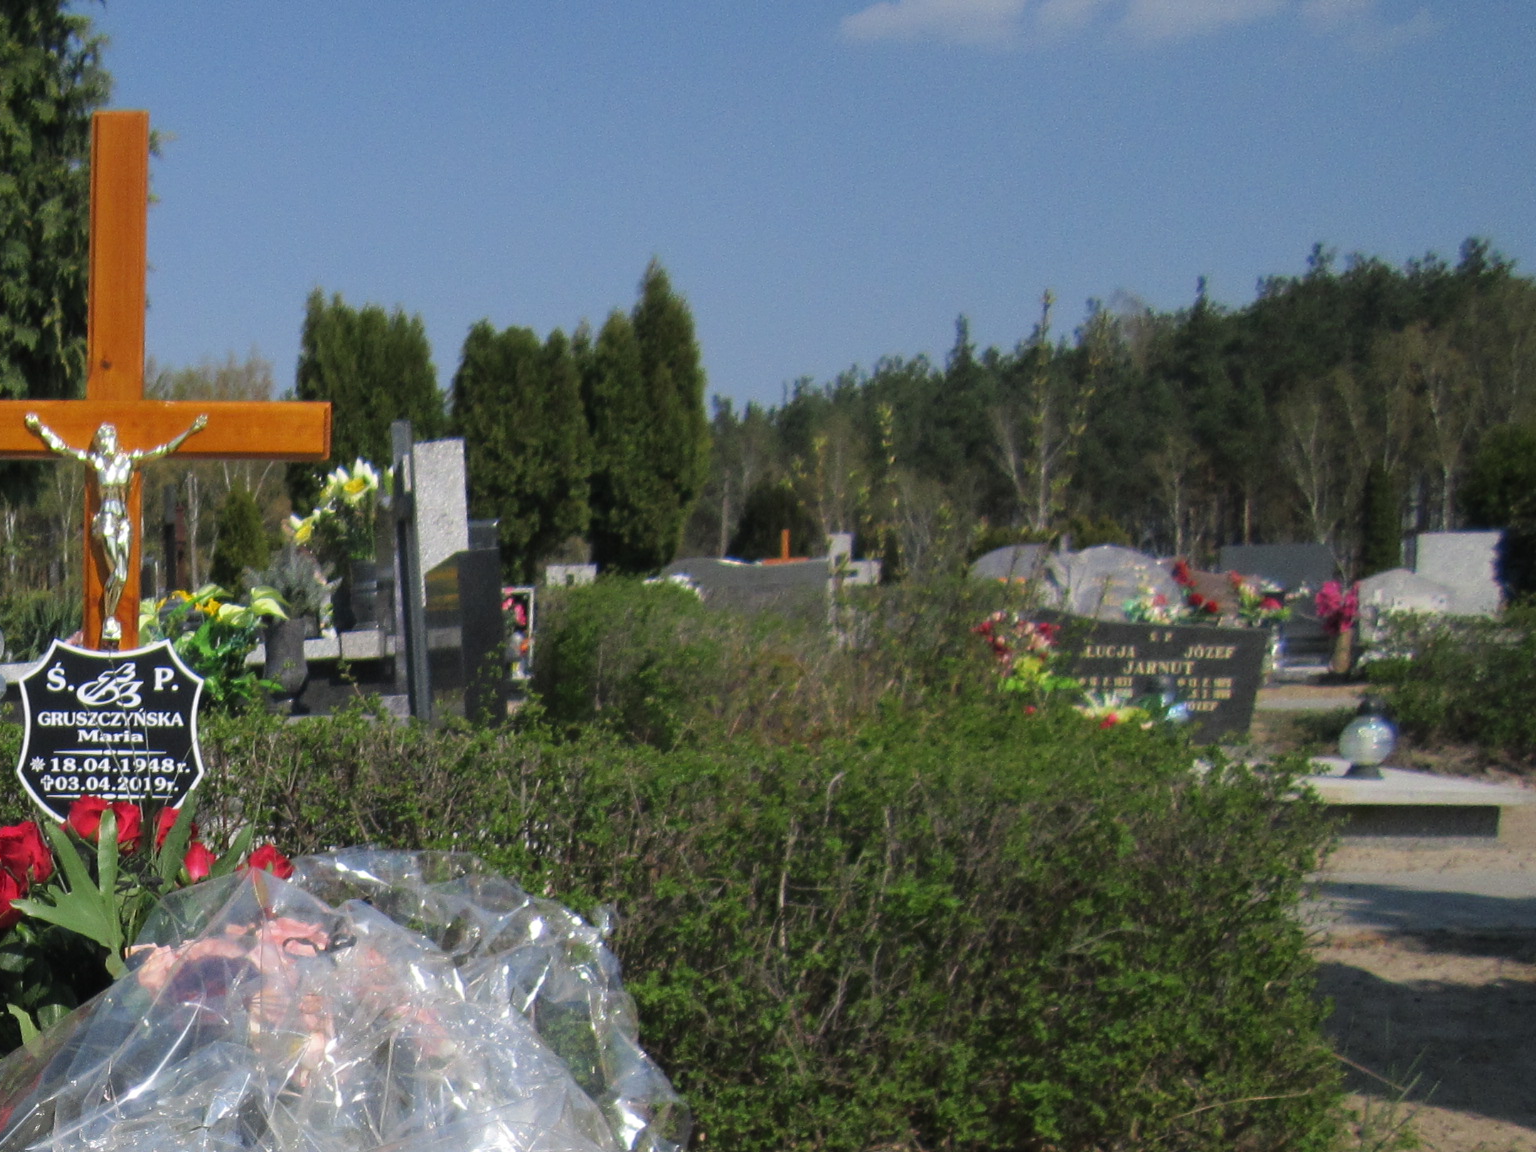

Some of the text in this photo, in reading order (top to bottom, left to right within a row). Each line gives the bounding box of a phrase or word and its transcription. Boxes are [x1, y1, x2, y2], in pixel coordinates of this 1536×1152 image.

[46, 662, 179, 691] Ś. P.
[1123, 661, 1195, 675] JARNUT
[37, 707, 184, 727] GRUSZCZYŃSKA
[77, 729, 144, 743] Maria
